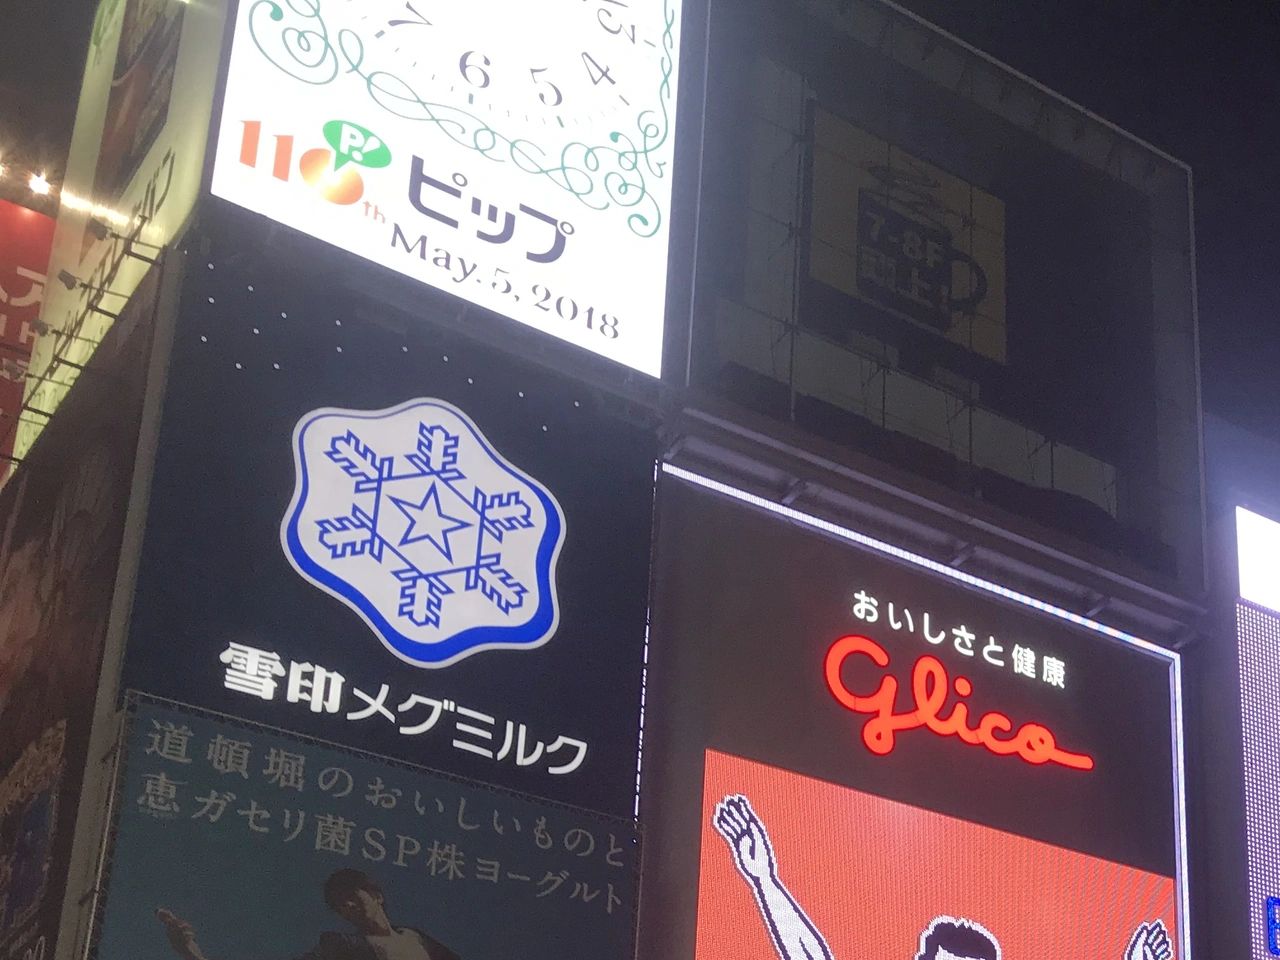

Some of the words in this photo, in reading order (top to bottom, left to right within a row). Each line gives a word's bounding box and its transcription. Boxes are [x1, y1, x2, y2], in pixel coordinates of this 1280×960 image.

[459, 51, 490, 88] 6
[530, 67, 562, 106] 5
[581, 51, 616, 85] 4
[408, 154, 576, 264] ピップ
[531, 284, 619, 339] 2018
[853, 590, 1067, 688] おいしさと健康
[219, 641, 588, 776] 雪印メグミルク
[825, 635, 1094, 769] Glico
